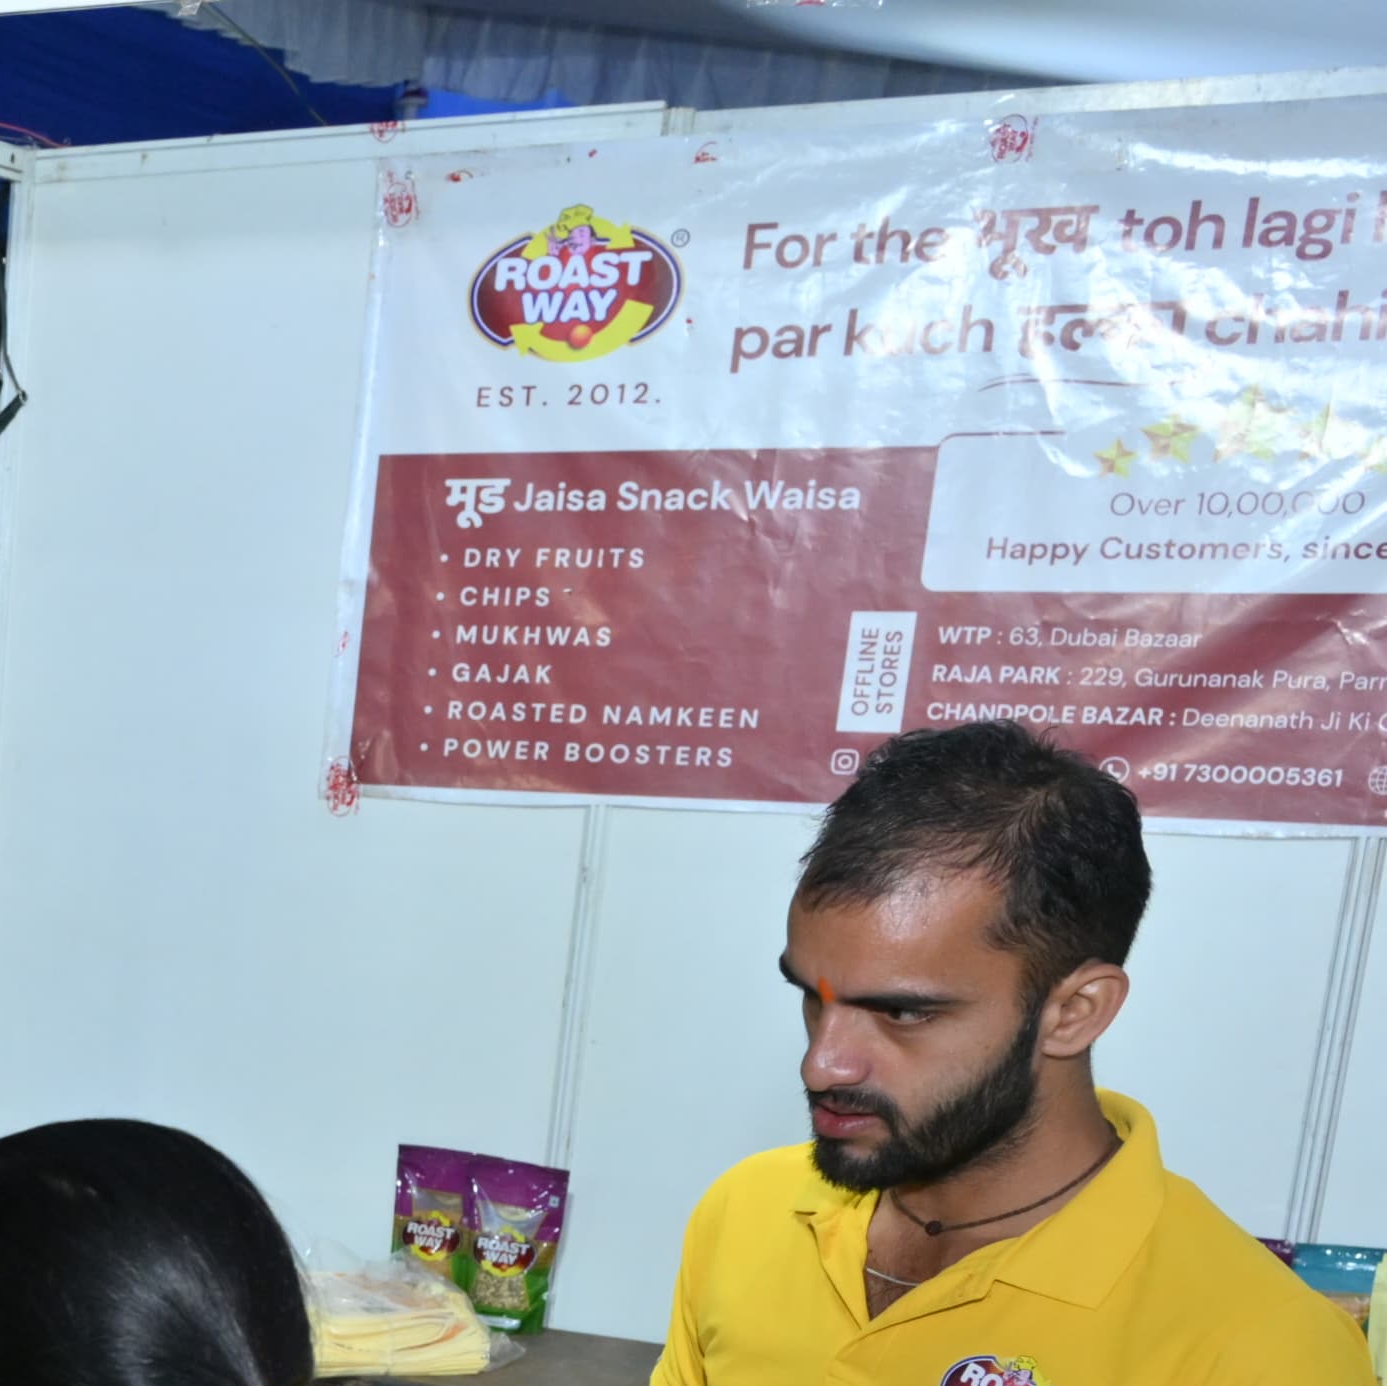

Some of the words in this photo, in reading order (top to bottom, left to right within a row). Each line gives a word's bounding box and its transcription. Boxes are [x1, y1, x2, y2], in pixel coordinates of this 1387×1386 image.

[743, 222, 836, 270] For
[851, 216, 950, 265] the
[978, 203, 1100, 281] भूख
[1121, 199, 1226, 252] toh
[1240, 191, 1360, 262] lagi
[495, 250, 652, 292] ROAST
[521, 289, 617, 324] WAY
[730, 322, 832, 374] par
[476, 384, 549, 408] EST.
[567, 382, 662, 406] 2012.
[444, 478, 512, 529] मूड
[514, 481, 606, 512] Jaisa
[617, 480, 731, 512] Snack
[744, 481, 861, 511] Waisa
[1109, 492, 1186, 517] Over
[463, 548, 522, 568] DRY
[534, 547, 645, 569] FRUITS
[986, 537, 1090, 566] Happy
[1099, 537, 1292, 564] Customers,
[1301, 537, 1387, 561] since
[459, 587, 551, 607] CHIPS
[455, 625, 613, 648] MUKHWAS
[938, 626, 992, 645] WTP
[1009, 627, 1042, 648] 63,
[1050, 626, 1117, 648] Dubai
[1125, 629, 1203, 649] Bazaar
[451, 664, 553, 685] GAJAK
[851, 627, 881, 718] OFFLINE
[876, 629, 904, 715] STORES
[932, 665, 994, 685] RAJA
[999, 665, 1061, 686] PARK
[1080, 667, 1127, 689] 229,
[1135, 668, 1264, 690] Gurunanak
[1272, 671, 1330, 692] Pura,
[447, 701, 588, 725] ROASTED
[602, 705, 760, 730] NAMKEEN
[927, 701, 1076, 725] CHANDPOLE
[1081, 706, 1164, 727] BAZAR
[1182, 709, 1313, 731] Deenanath
[1320, 711, 1341, 732] Ji
[1349, 711, 1371, 732] Ki
[443, 739, 550, 762] POWER
[563, 742, 734, 768] BOOSTERS
[1137, 764, 1177, 785] +91
[1184, 764, 1344, 788] 7300005361
[407, 1222, 456, 1240] ROAST
[413, 1234, 443, 1250] WAY
[477, 1236, 531, 1255] ROAST
[484, 1250, 518, 1266] WAY
